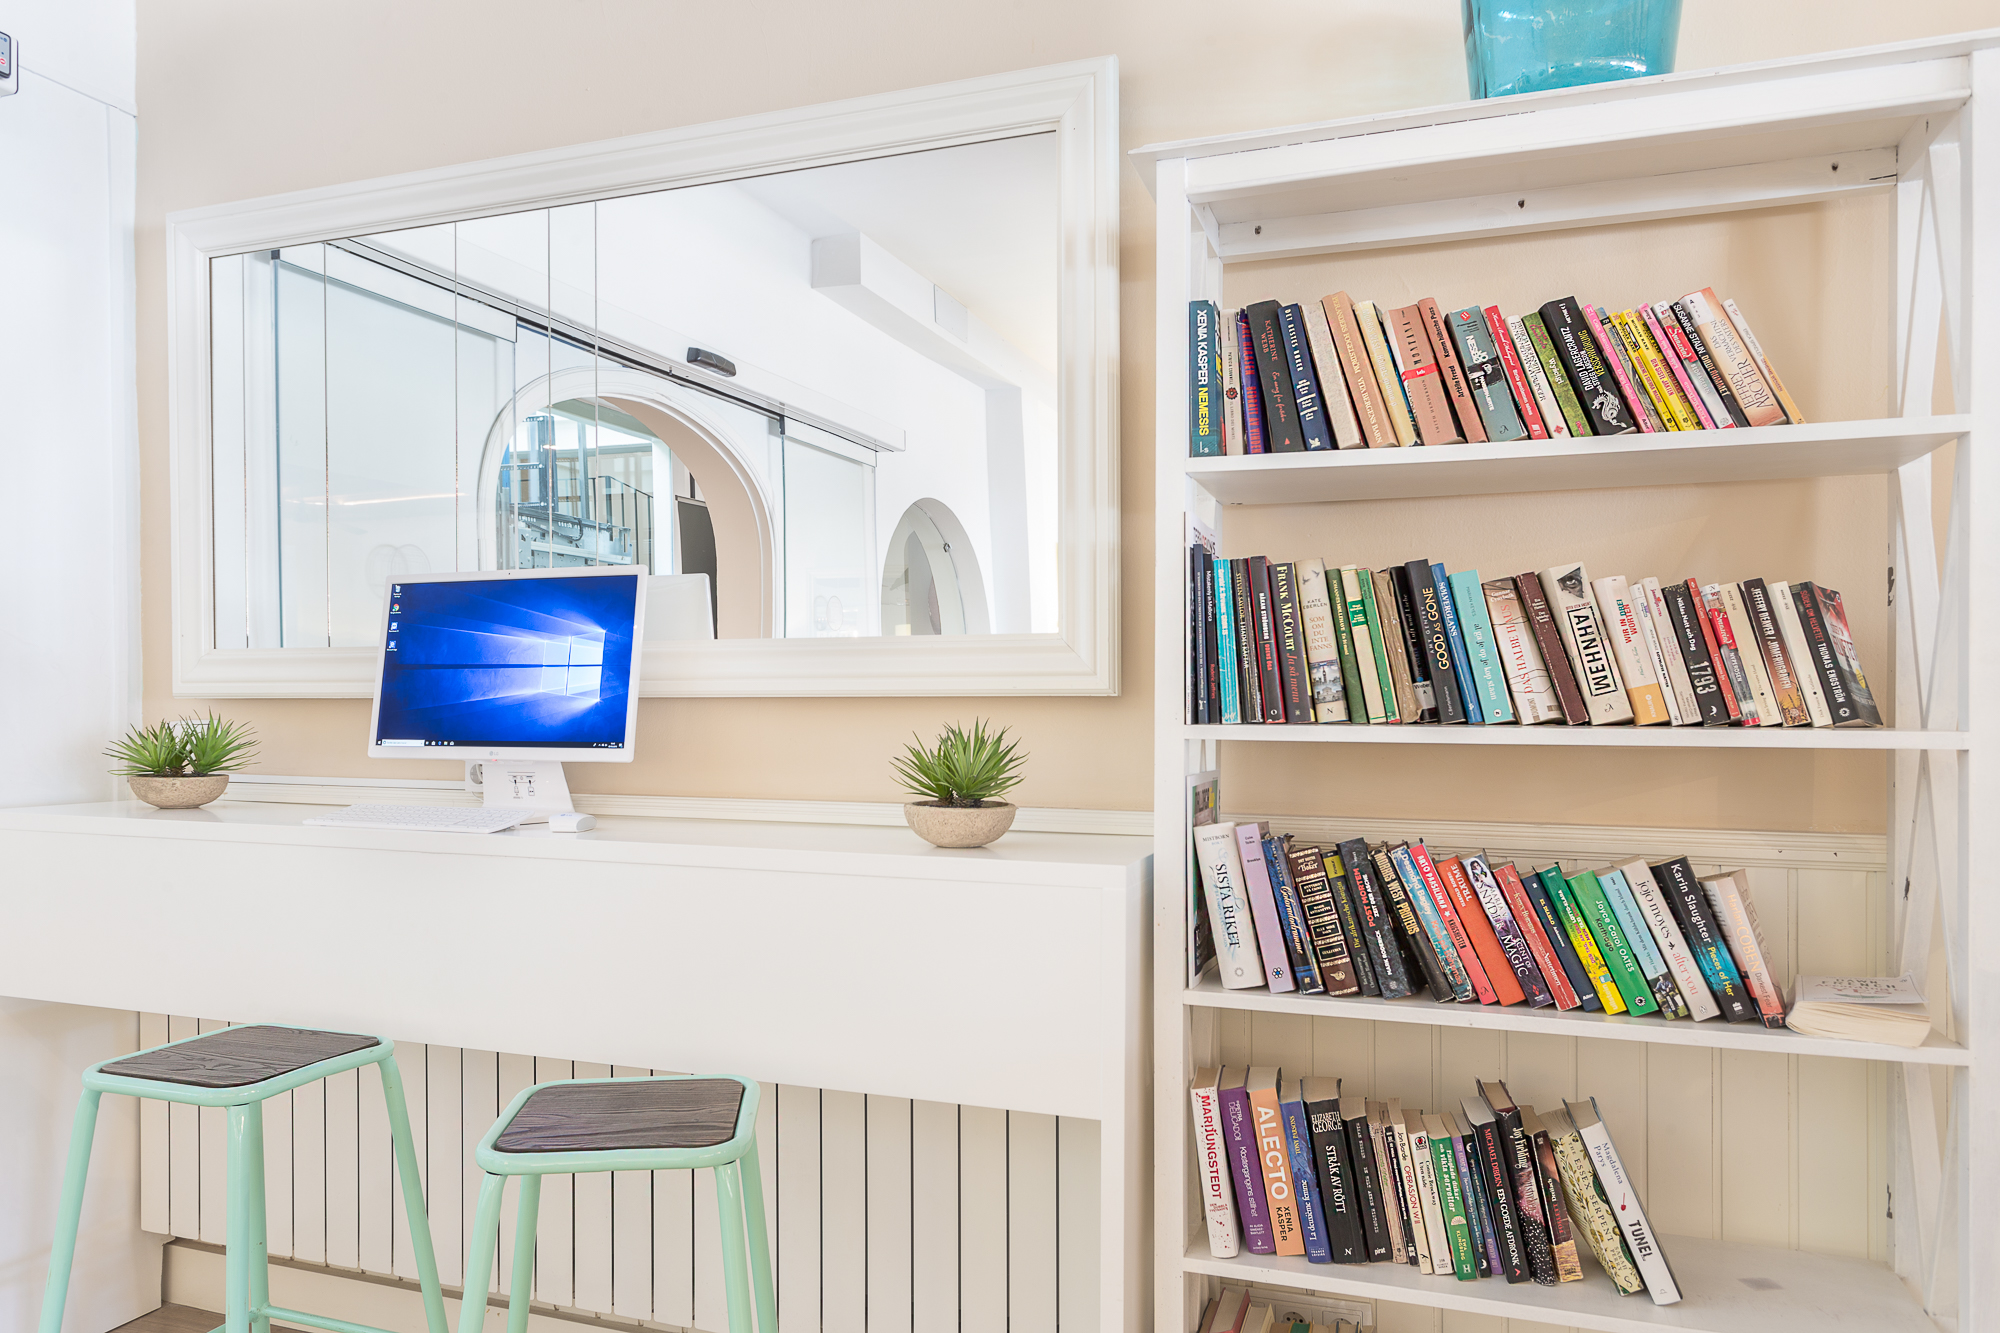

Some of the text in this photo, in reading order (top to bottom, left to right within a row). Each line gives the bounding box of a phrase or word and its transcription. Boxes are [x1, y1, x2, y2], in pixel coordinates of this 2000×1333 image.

[1283, 309, 1293, 321] DET
[1672, 302, 1694, 334] SUSANNE
[1259, 332, 1269, 353] WEBB
[1263, 319, 1277, 361] KATHERINE
[1401, 320, 1423, 365] MONTANA
[1577, 327, 1605, 378] VERSCHWÖRUNG
[1709, 334, 1721, 349] DAS
[1717, 317, 1742, 354] DES VATERS
[1196, 309, 1209, 436] XENIA KASPER NEMESIS
[1241, 340, 1255, 375] HIAASEN
[1559, 323, 1594, 391] DAVID LAGERCRANTZ
[1727, 368, 1761, 409] JEFFREY
[1735, 357, 1773, 411] ARCHER
[1371, 424, 1382, 443] BARN
[1204, 570, 1212, 595] Mistakenly
[1275, 565, 1290, 599] FRANK
[1303, 602, 1328, 610] EBERLEN
[1420, 605, 1430, 634] GENTRY
[1436, 581, 1458, 637] SØLVERGLANS
[1464, 586, 1476, 617] MARIAN KEYES
[1614, 597, 1632, 643] WIR IN DREI
[1621, 602, 1638, 635] WORTEN
[1311, 636, 1329, 644] INTE
[1313, 629, 1324, 637] DU
[1422, 586, 1450, 670] GOOD AS GONE
[1675, 596, 1698, 651] Niklas Natt och Dag
[1286, 652, 1297, 665] Ja
[1310, 642, 1333, 652] FANNS
[1473, 622, 1498, 700] al ga je op je kop staan
[1499, 602, 1534, 694] DAS HALBE HAUS
[1572, 610, 1611, 691] AHNHEM
[1288, 665, 1299, 676] så
[1688, 659, 1718, 696] 1793
[1816, 641, 1834, 669] THOMAS
[1825, 667, 1846, 703] ENGSTRÖM
[1289, 677, 1299, 703] menn
[1202, 833, 1230, 843] MISTBORN
[1415, 853, 1430, 873] ARTO
[1352, 866, 1368, 904] MORTEM
[1361, 872, 1380, 917] ZEIT DER ASCHE
[1373, 850, 1420, 937] MORRIS WEST PROTEUS
[1399, 853, 1433, 917] Desmond Bagley
[1488, 885, 1505, 910] MARIA
[1213, 862, 1241, 949] SISTA RIKET
[1335, 879, 1361, 948] Die afrikanische Königin
[1363, 903, 1376, 927] POST
[1475, 880, 1506, 931] SNYDER
[1374, 928, 1387, 958] RODERICK
[1557, 888, 1596, 963] DER AN LOTTO-KLARA
[1575, 915, 1591, 941] MEIN TAXI
[1593, 916, 1616, 953] Karthago
[1594, 898, 1634, 973] Joyce Carol OATES
[1634, 877, 1699, 997] jojo moyes after you
[1670, 862, 1735, 998] Karin Slaughter Pieces of Her
[1382, 957, 1392, 976] MARK
[1499, 932, 1530, 979] MAGIC
[1724, 893, 1774, 1009] Harlan COBEN Darkest Fear
[1601, 982, 1618, 1011] ullstein
[1311, 1111, 1340, 1124] ELIZABETH
[1312, 1119, 1343, 1133] GEORGE
[1508, 1125, 1525, 1140] Joy
[1255, 1103, 1289, 1201] ALECTO
[1292, 1139, 1301, 1155] TONY
[1510, 1138, 1531, 1170] Fielding
[1592, 1143, 1608, 1168] Parys
[1600, 1140, 1625, 1185] Magdalena
[1324, 1144, 1347, 1215] STRÅK AV RÖTT
[1402, 1164, 1418, 1209] OPERASJON
[1438, 1153, 1456, 1213] vikta servetter
[1451, 1179, 1460, 1201] dukar
[1483, 1127, 1520, 1266] MICHAEL DIBDIN EEN GOEDE AFDRONK
[1567, 1141, 1614, 1243] THE ESSEX SERPENT
[1274, 1206, 1288, 1242] KASPER
[1282, 1205, 1294, 1233] XENIA
[1298, 1177, 1317, 1241] La deuxième femme
[1373, 1246, 1386, 1256] pirat
[1609, 1248, 1623, 1272] PERRY
[1613, 1245, 1627, 1271] SARAH
